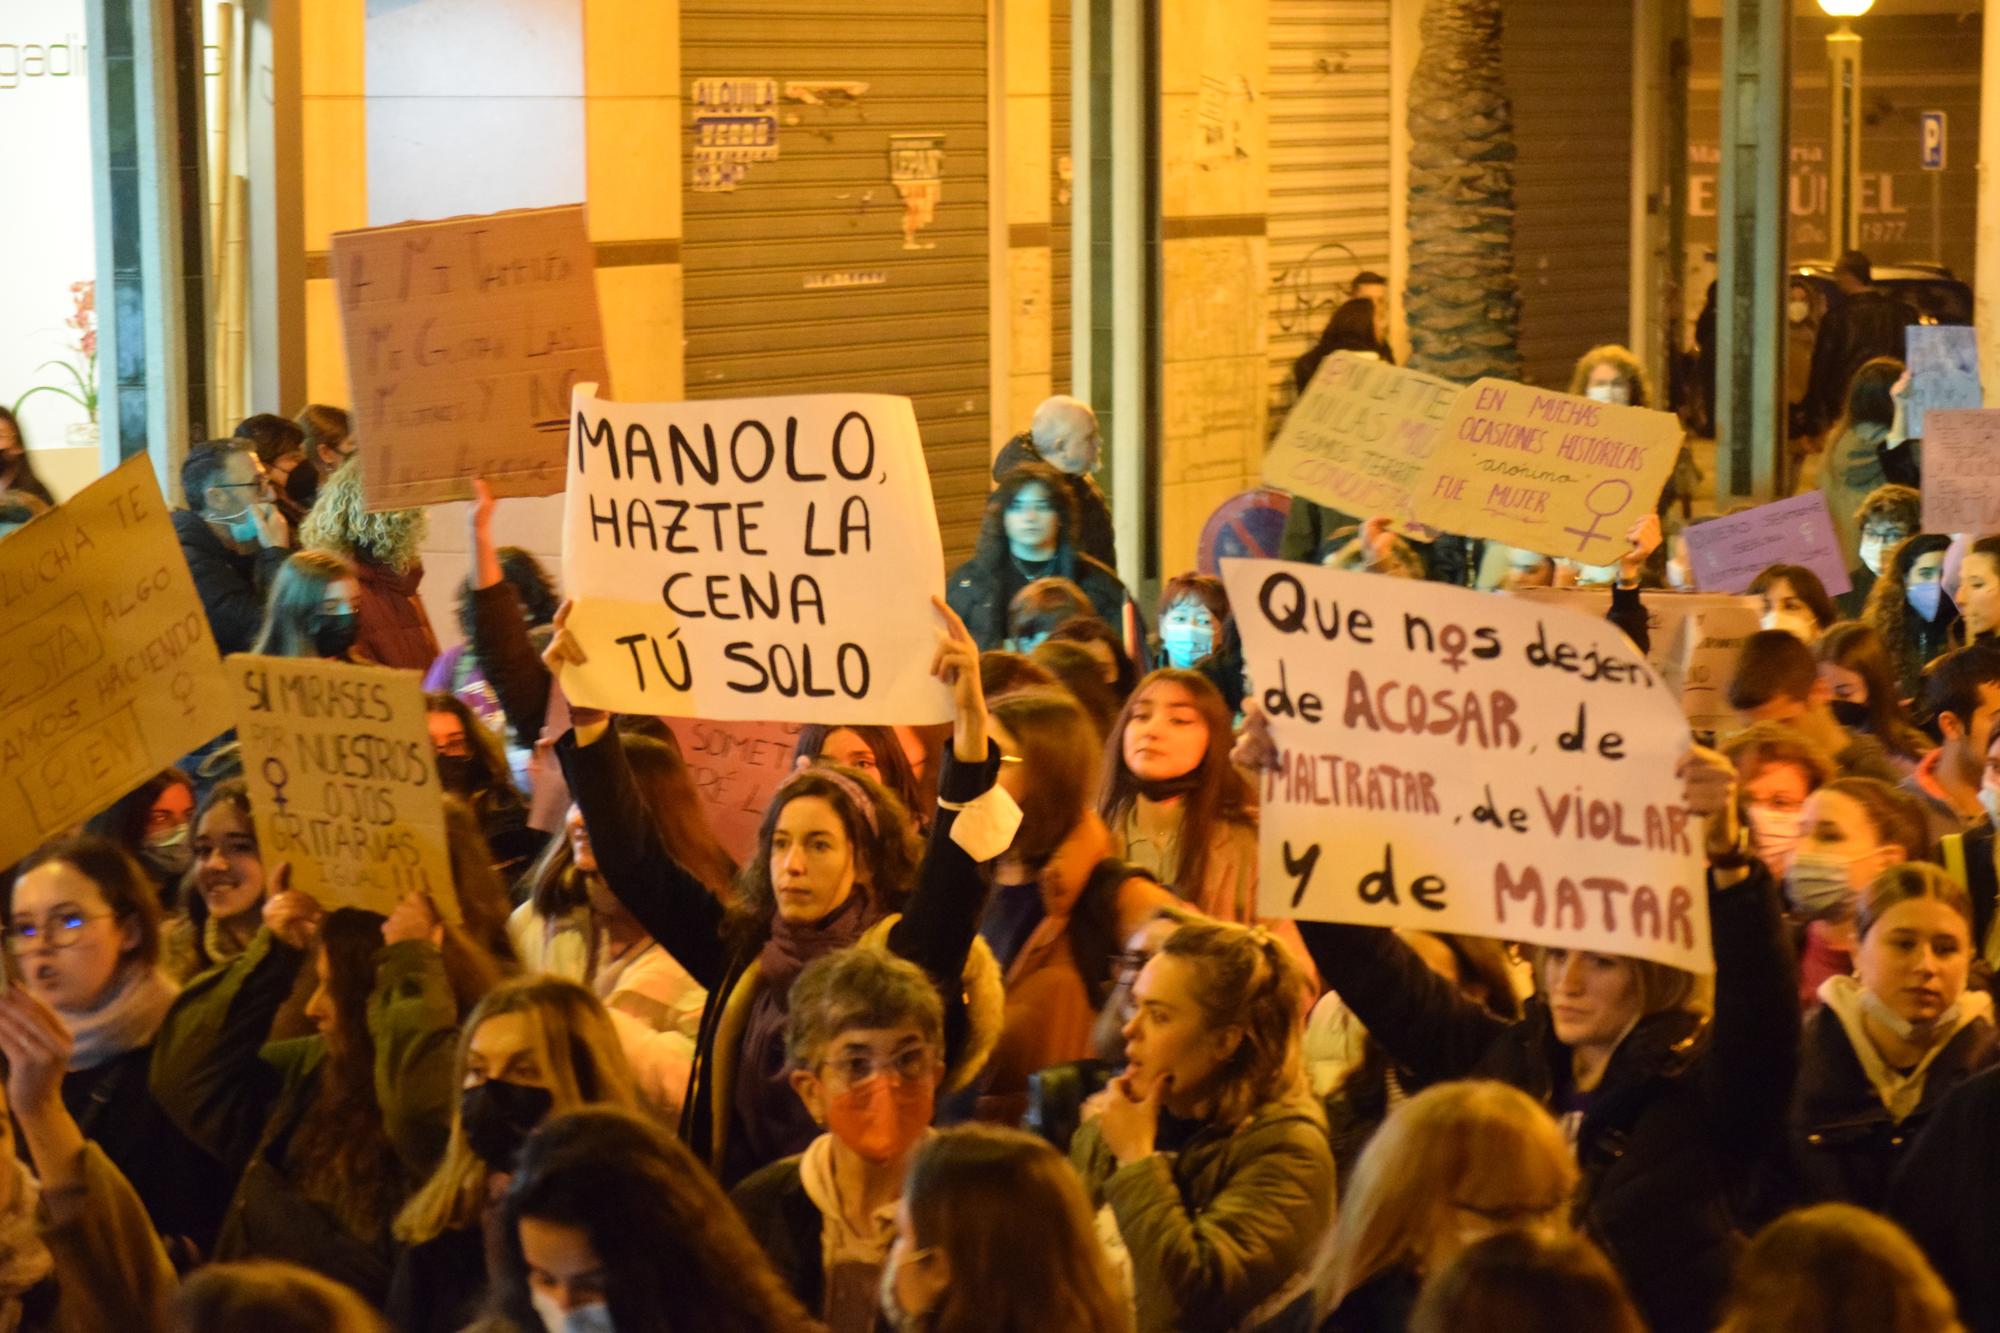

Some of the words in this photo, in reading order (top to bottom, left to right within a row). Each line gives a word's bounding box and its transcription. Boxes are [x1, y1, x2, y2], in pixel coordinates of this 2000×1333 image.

[1475, 386, 1509, 412] EN
[576, 410, 887, 486] MANOLO,
[1457, 415, 1549, 457] OCASIONES
[109, 483, 148, 531] TE
[1432, 473, 1470, 502] FUE
[1485, 482, 1552, 514] MUJER
[589, 493, 768, 556] HAZTE
[804, 495, 871, 556] LA
[102, 565, 172, 627] ALGO
[662, 571, 826, 626] CENA
[1258, 572, 1374, 644] Que
[1525, 619, 1655, 690] dejen
[614, 627, 692, 693] TÚ
[723, 641, 871, 699] SOLO
[243, 669, 272, 713] SI
[278, 673, 393, 723] MIRASES
[1263, 658, 1323, 723] de
[1557, 702, 1627, 761] de
[295, 732, 429, 787] NUESTROS
[322, 781, 396, 826] OJOS
[1472, 784, 1528, 832] de
[1357, 842, 1447, 911] de
[1493, 861, 1694, 951] MATAR
